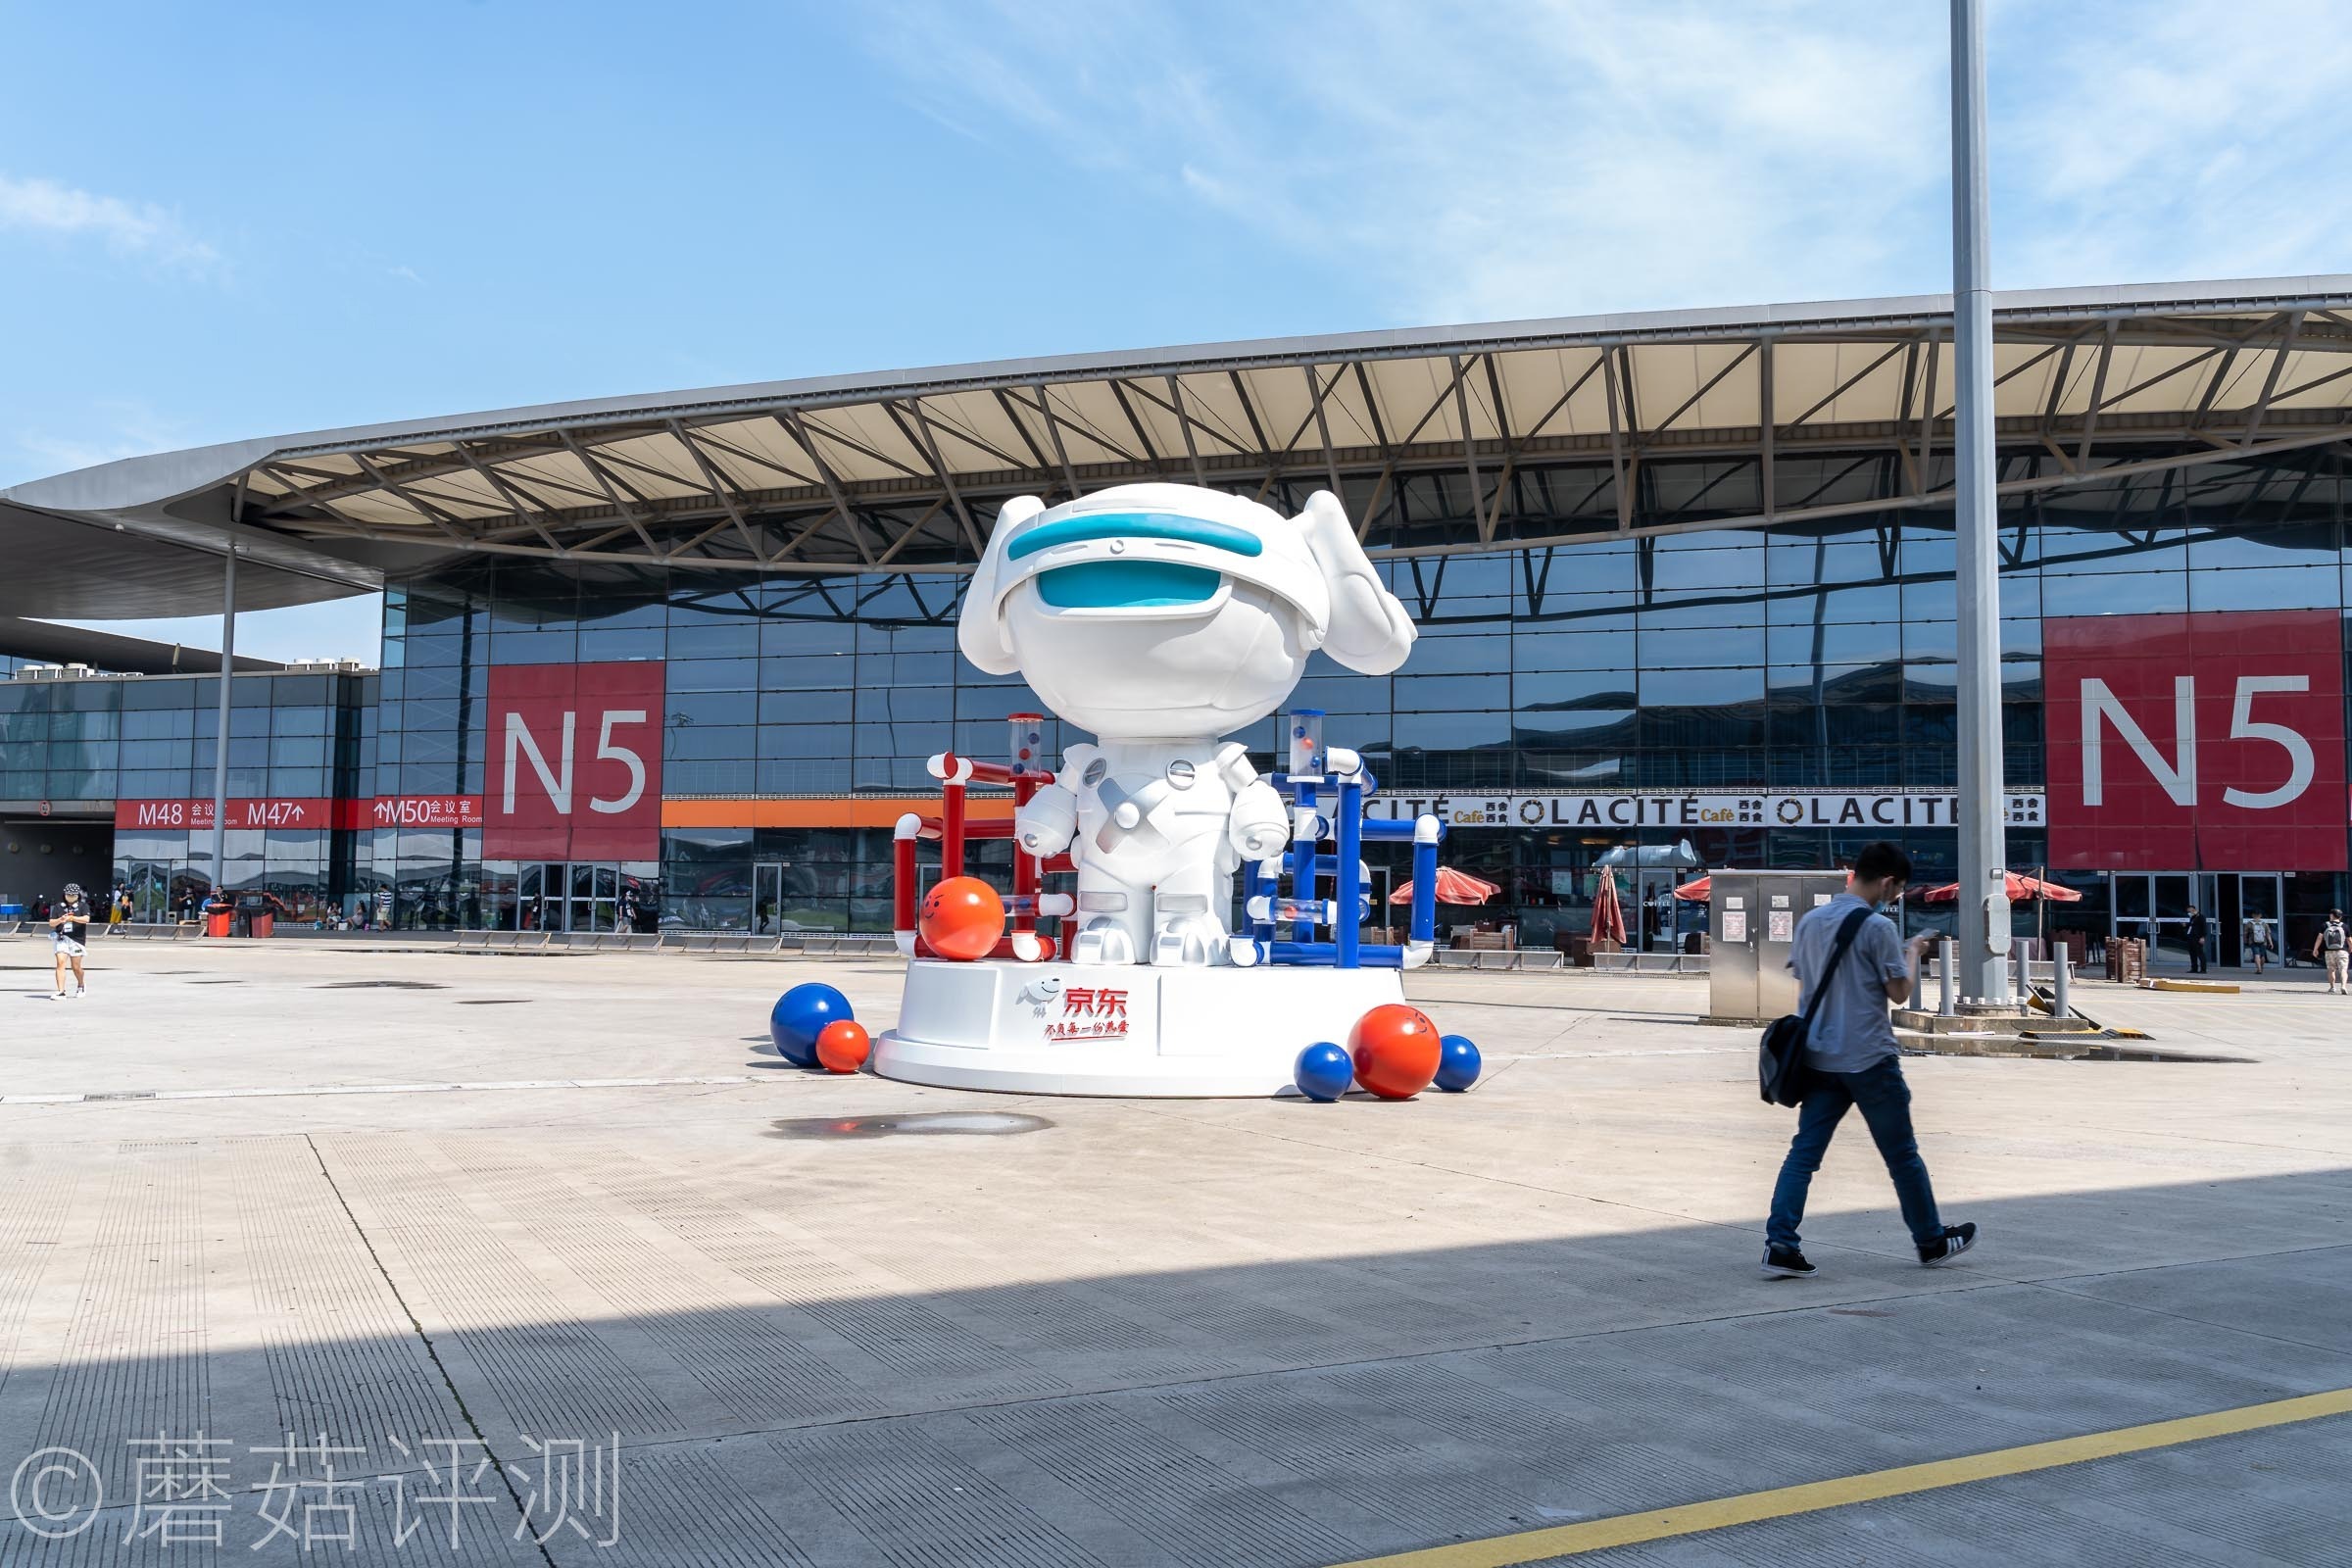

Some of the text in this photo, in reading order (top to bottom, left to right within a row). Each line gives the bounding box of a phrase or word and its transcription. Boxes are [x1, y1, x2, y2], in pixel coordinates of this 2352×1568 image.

[2081, 675, 2315, 809] N5
[503, 710, 647, 814] N5
[138, 803, 182, 825] M48
[191, 803, 226, 816] 会议
[247, 802, 293, 825] M47
[385, 800, 430, 823] M50
[430, 800, 470, 813] 会议室
[431, 815, 458, 824] Meeting
[1064, 987, 1129, 1016] 京东
[1044, 1020, 1130, 1036] 不负每一份热爱
